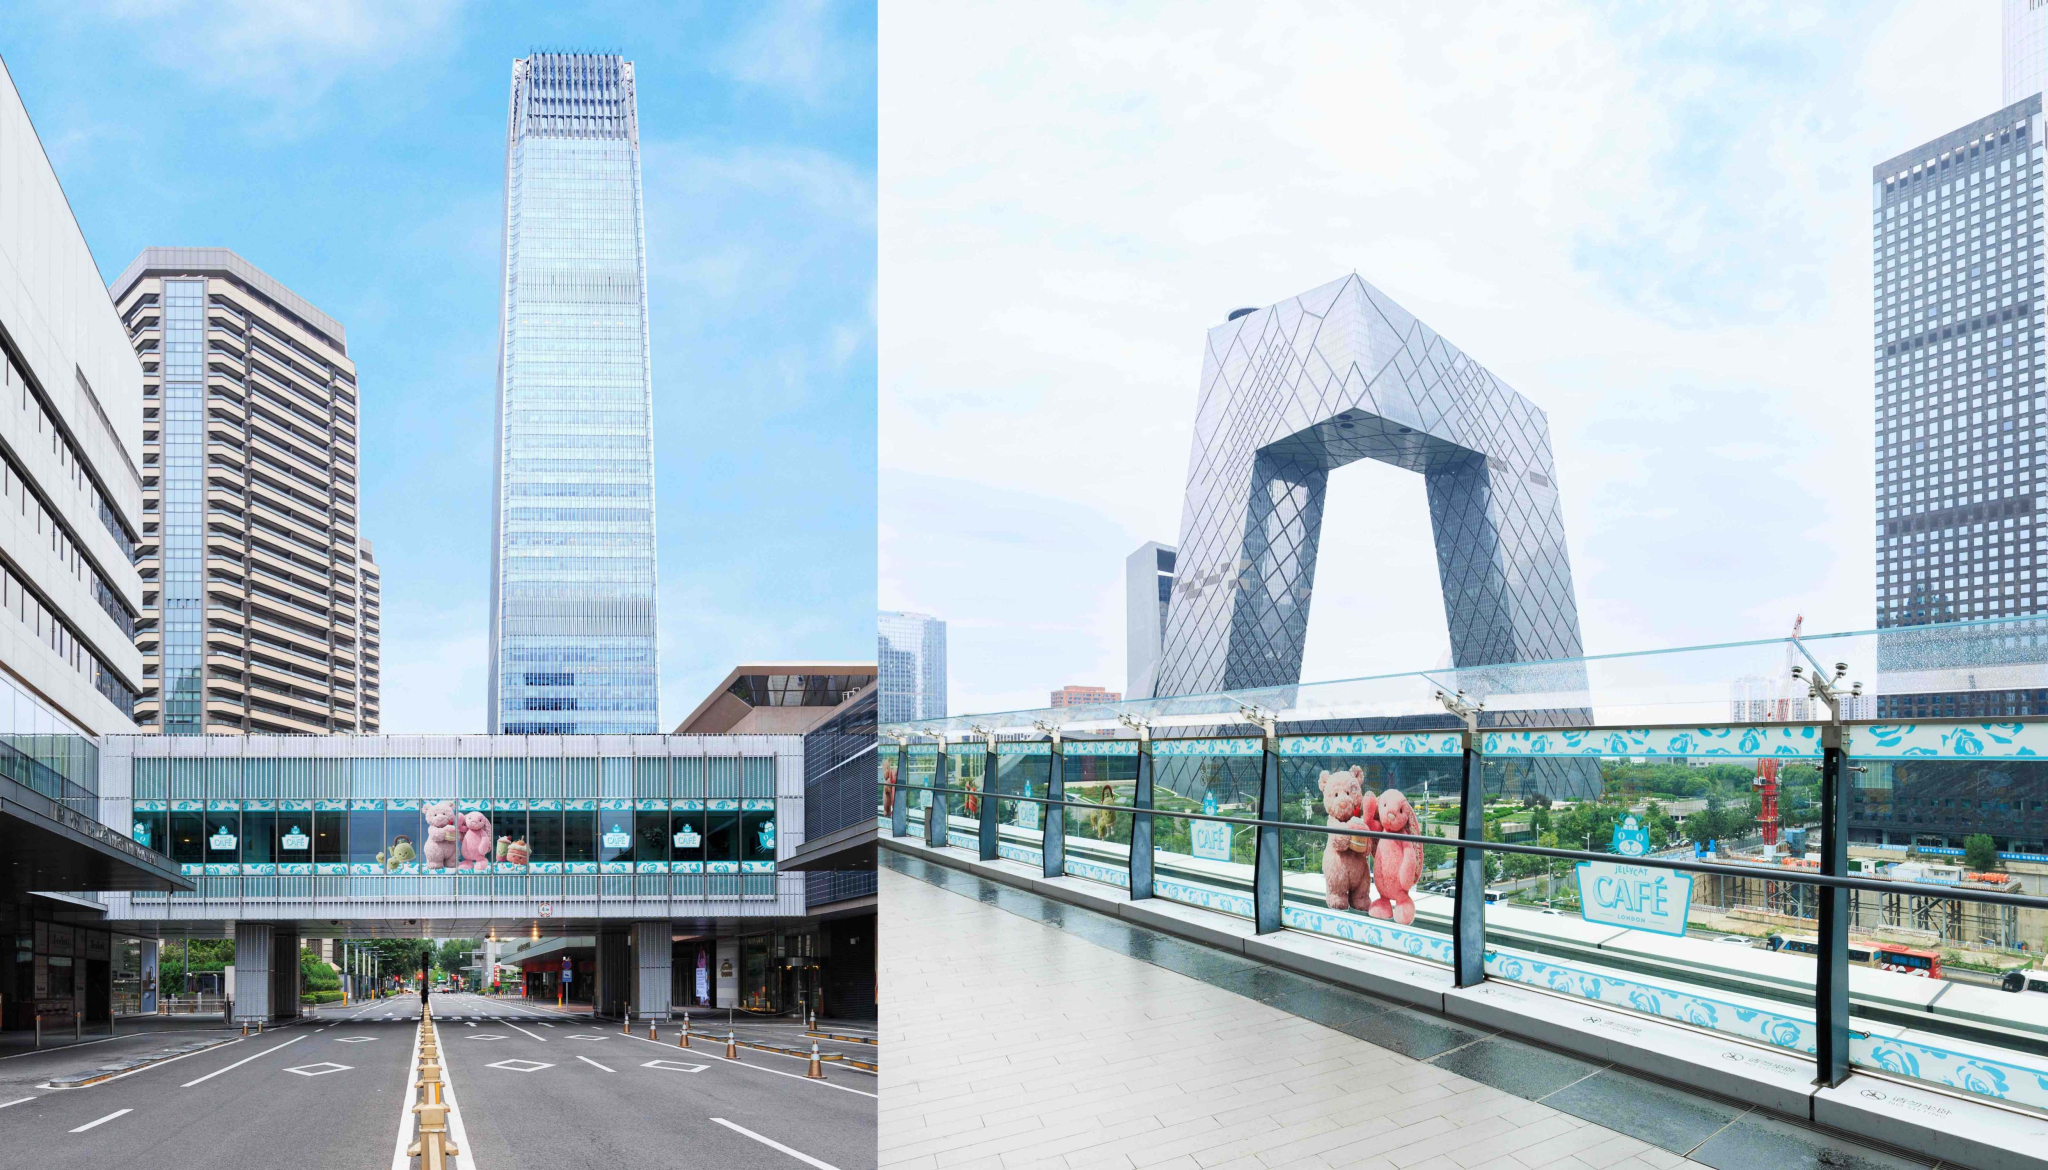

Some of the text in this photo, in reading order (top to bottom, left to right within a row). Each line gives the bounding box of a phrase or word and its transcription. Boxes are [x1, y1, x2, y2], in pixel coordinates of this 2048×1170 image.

[1195, 826, 1225, 851] CAFÉ
[1593, 876, 1668, 916] CAFÉ
[1617, 914, 1646, 923] LONDON
[1888, 1100, 1947, 1119] NO SITTING
[1892, 1095, 1953, 1116] 请勿坐卧
